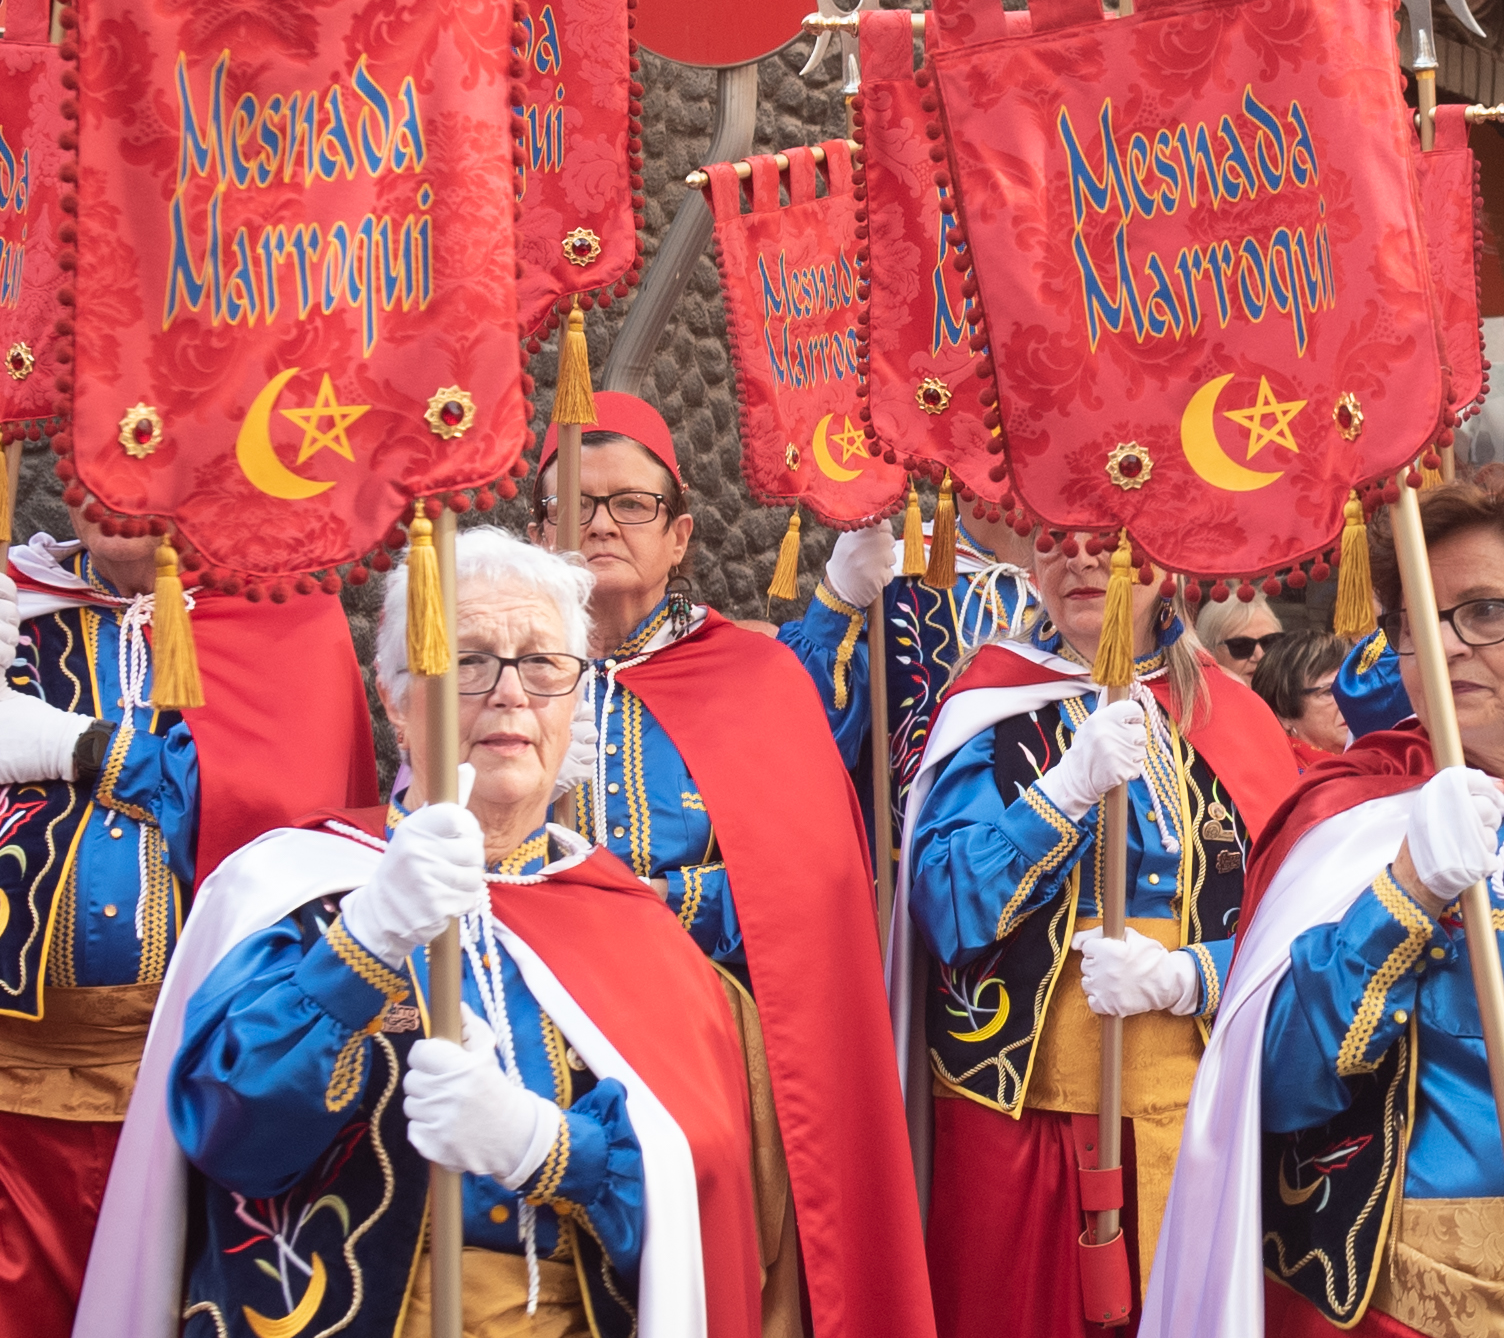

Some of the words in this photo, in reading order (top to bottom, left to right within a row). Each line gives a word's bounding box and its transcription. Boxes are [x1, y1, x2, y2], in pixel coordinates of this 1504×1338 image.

[176, 49, 428, 191] Mesnada
[1057, 84, 1319, 230] Mesnada
[163, 181, 434, 358] Marroqui
[1071, 201, 1337, 358] Marroqui
[763, 317, 870, 400] Marroq
